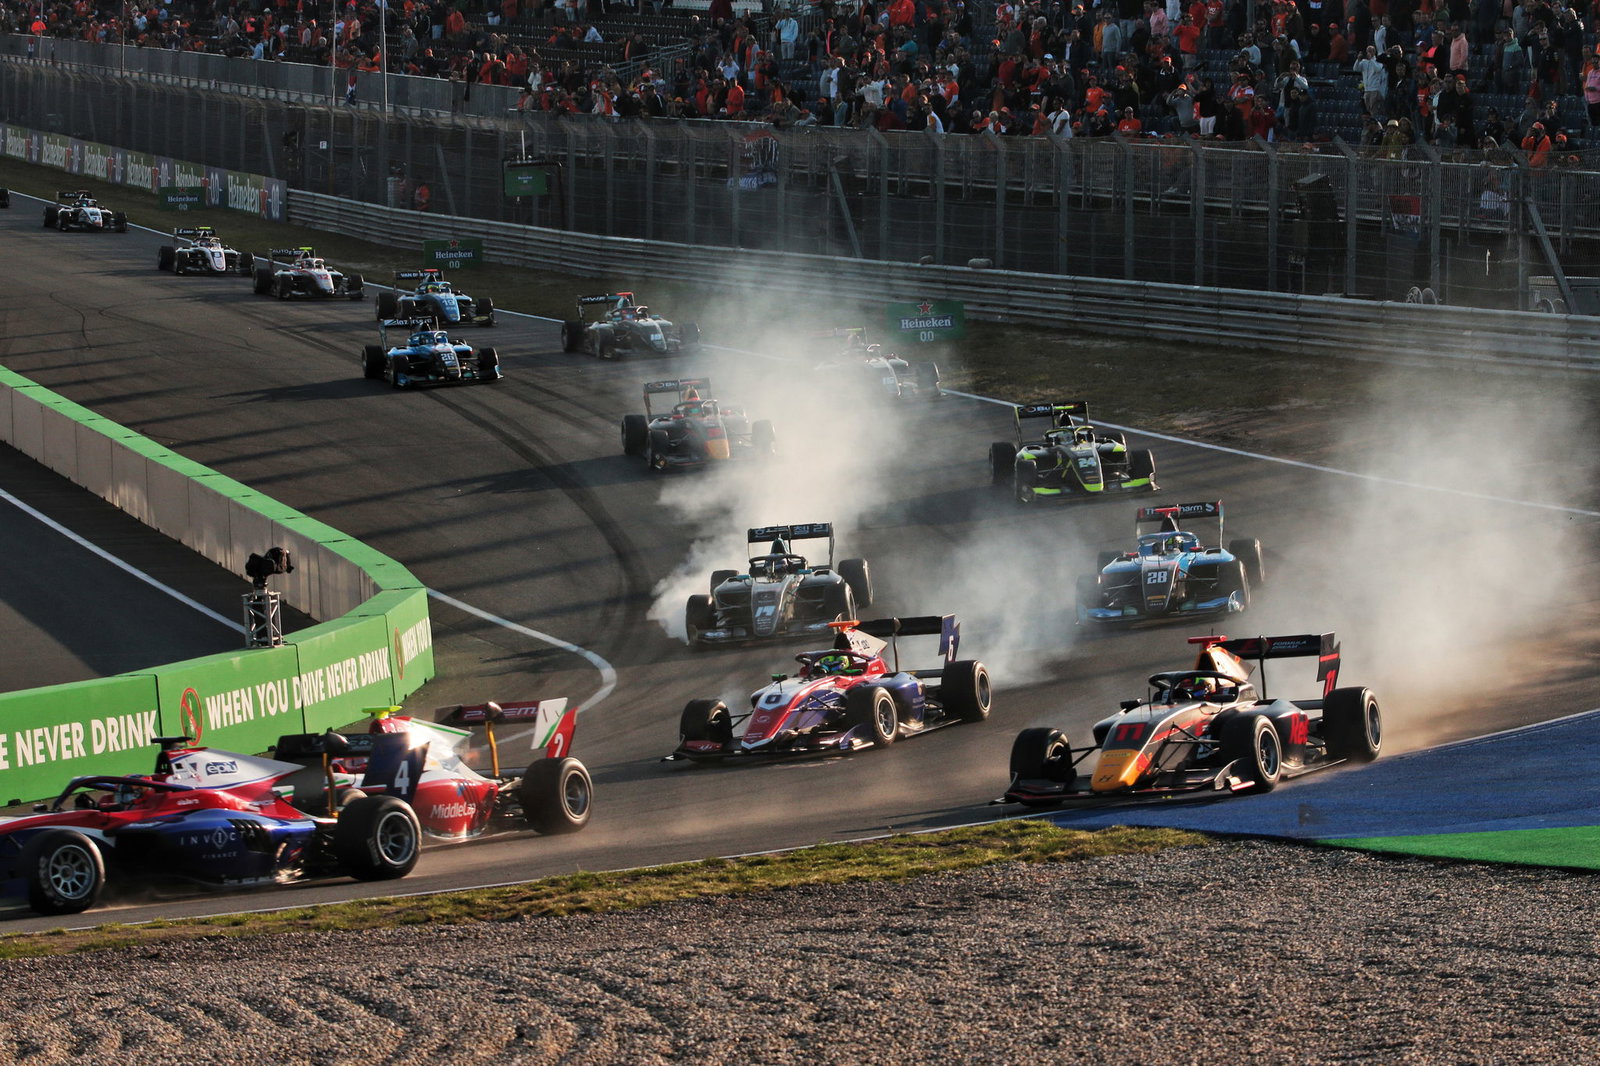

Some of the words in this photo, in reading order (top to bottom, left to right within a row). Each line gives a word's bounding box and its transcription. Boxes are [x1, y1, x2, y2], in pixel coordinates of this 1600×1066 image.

[228, 175, 260, 214] Heineken
[435, 250, 473, 259] Heineken
[901, 317, 951, 329] Heineken
[1078, 457, 1097, 468] 24
[1147, 571, 1168, 585] 28
[205, 687, 254, 731] WHEN
[256, 679, 289, 717] YOU
[292, 668, 326, 710] DRIVE
[326, 657, 359, 699] NEVER
[359, 646, 391, 687] DRINK
[463, 705, 539, 719] PEM
[15, 722, 86, 767] NEVER
[91, 710, 158, 755] DRINK
[1115, 723, 1146, 741] 11
[394, 760, 409, 794] 4
[430, 802, 476, 819] MiddleLap
[180, 829, 256, 846] INVICTA
